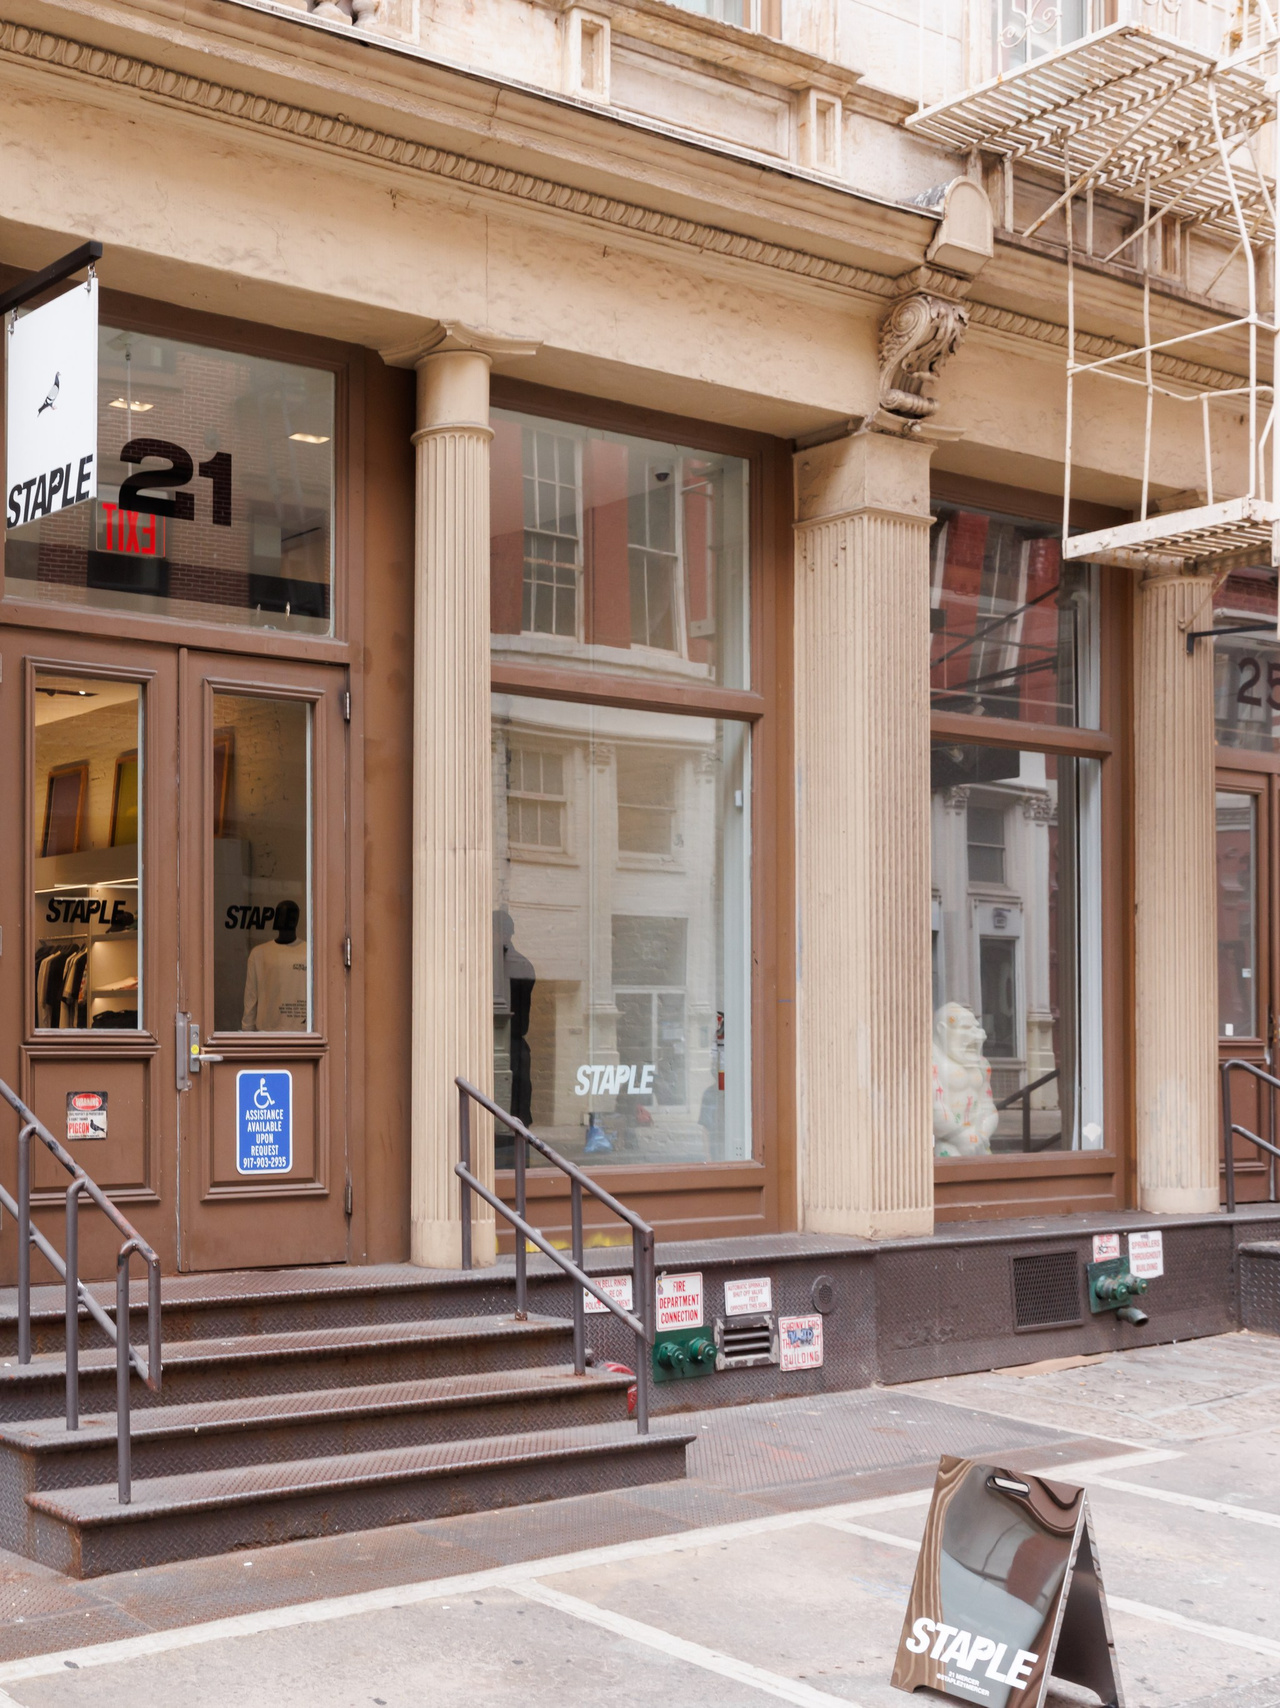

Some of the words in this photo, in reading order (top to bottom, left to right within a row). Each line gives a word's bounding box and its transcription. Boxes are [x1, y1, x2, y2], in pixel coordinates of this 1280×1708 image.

[118, 438, 232, 527] 21
[7, 454, 93, 528] STAPLE
[46, 897, 126, 924] STAPLE
[575, 1065, 655, 1096] STAPLE
[245, 1109, 284, 1120] ASSISTANCE
[68, 1122, 89, 1134] PIGEON
[247, 1121, 282, 1132] AVAILABLE
[256, 1133, 274, 1144] UPON
[251, 1145, 279, 1156] REQUEST
[243, 1156, 287, 1168] 917-903-2935
[602, 1280, 613, 1288] BELL
[614, 1278, 627, 1286] RINGS
[672, 1280, 686, 1292] FIRE
[659, 1294, 699, 1309] DEPARTMENT
[661, 1310, 699, 1324] CONNECTION
[905, 1617, 1039, 1690] STAPLE
